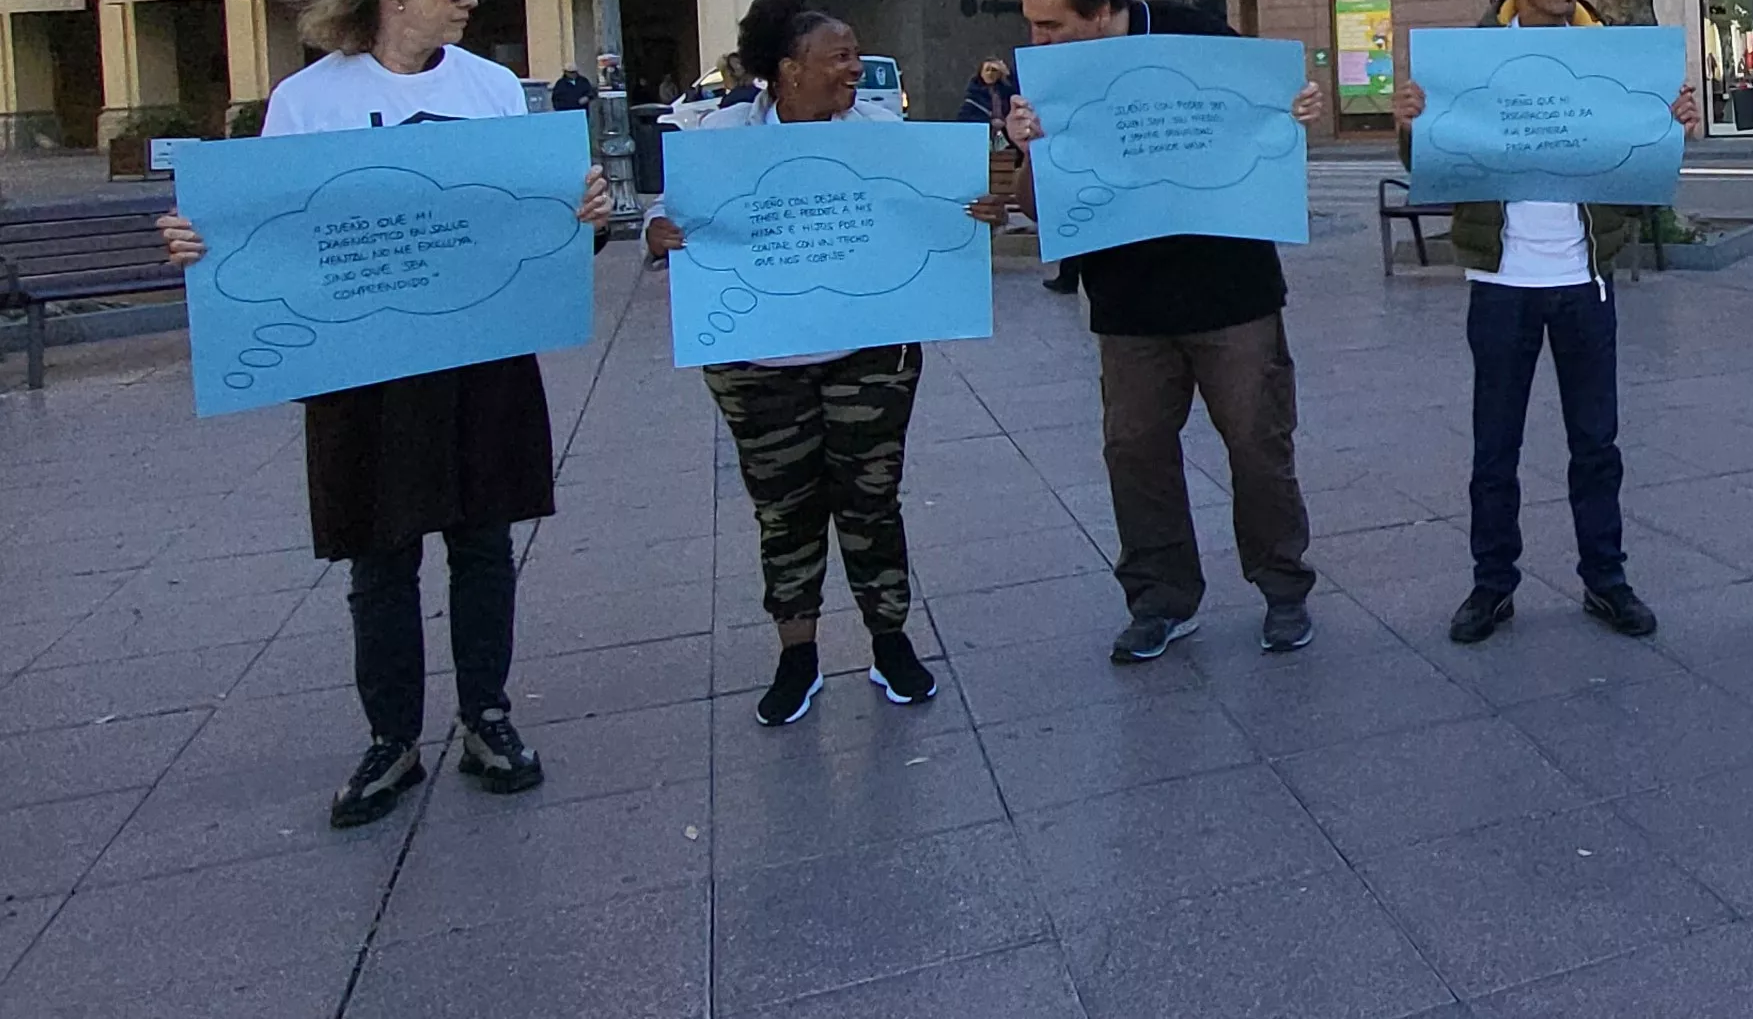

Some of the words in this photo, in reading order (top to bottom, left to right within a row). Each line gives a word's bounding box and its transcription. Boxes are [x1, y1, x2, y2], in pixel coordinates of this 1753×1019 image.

[788, 197, 808, 207] CON
[814, 192, 847, 204] DEJAR
[853, 192, 867, 201] DE
[842, 206, 850, 214] A
[377, 214, 407, 228] QUE
[416, 210, 432, 221] MI
[788, 225, 795, 234] E
[838, 220, 858, 230] POR
[860, 218, 874, 227] NO
[410, 228, 425, 237] EN
[429, 220, 469, 234] SALUD
[751, 242, 792, 253] CONTAR
[796, 240, 815, 249] CON
[836, 234, 870, 244] TECHO
[320, 253, 368, 267] MENTAL
[372, 249, 390, 259] NO
[394, 244, 412, 255] ME
[754, 256, 775, 267] QUE
[779, 254, 800, 265] NOS
[323, 271, 356, 286] SINO
[361, 264, 392, 277] QUE
[403, 260, 428, 272] SEA
